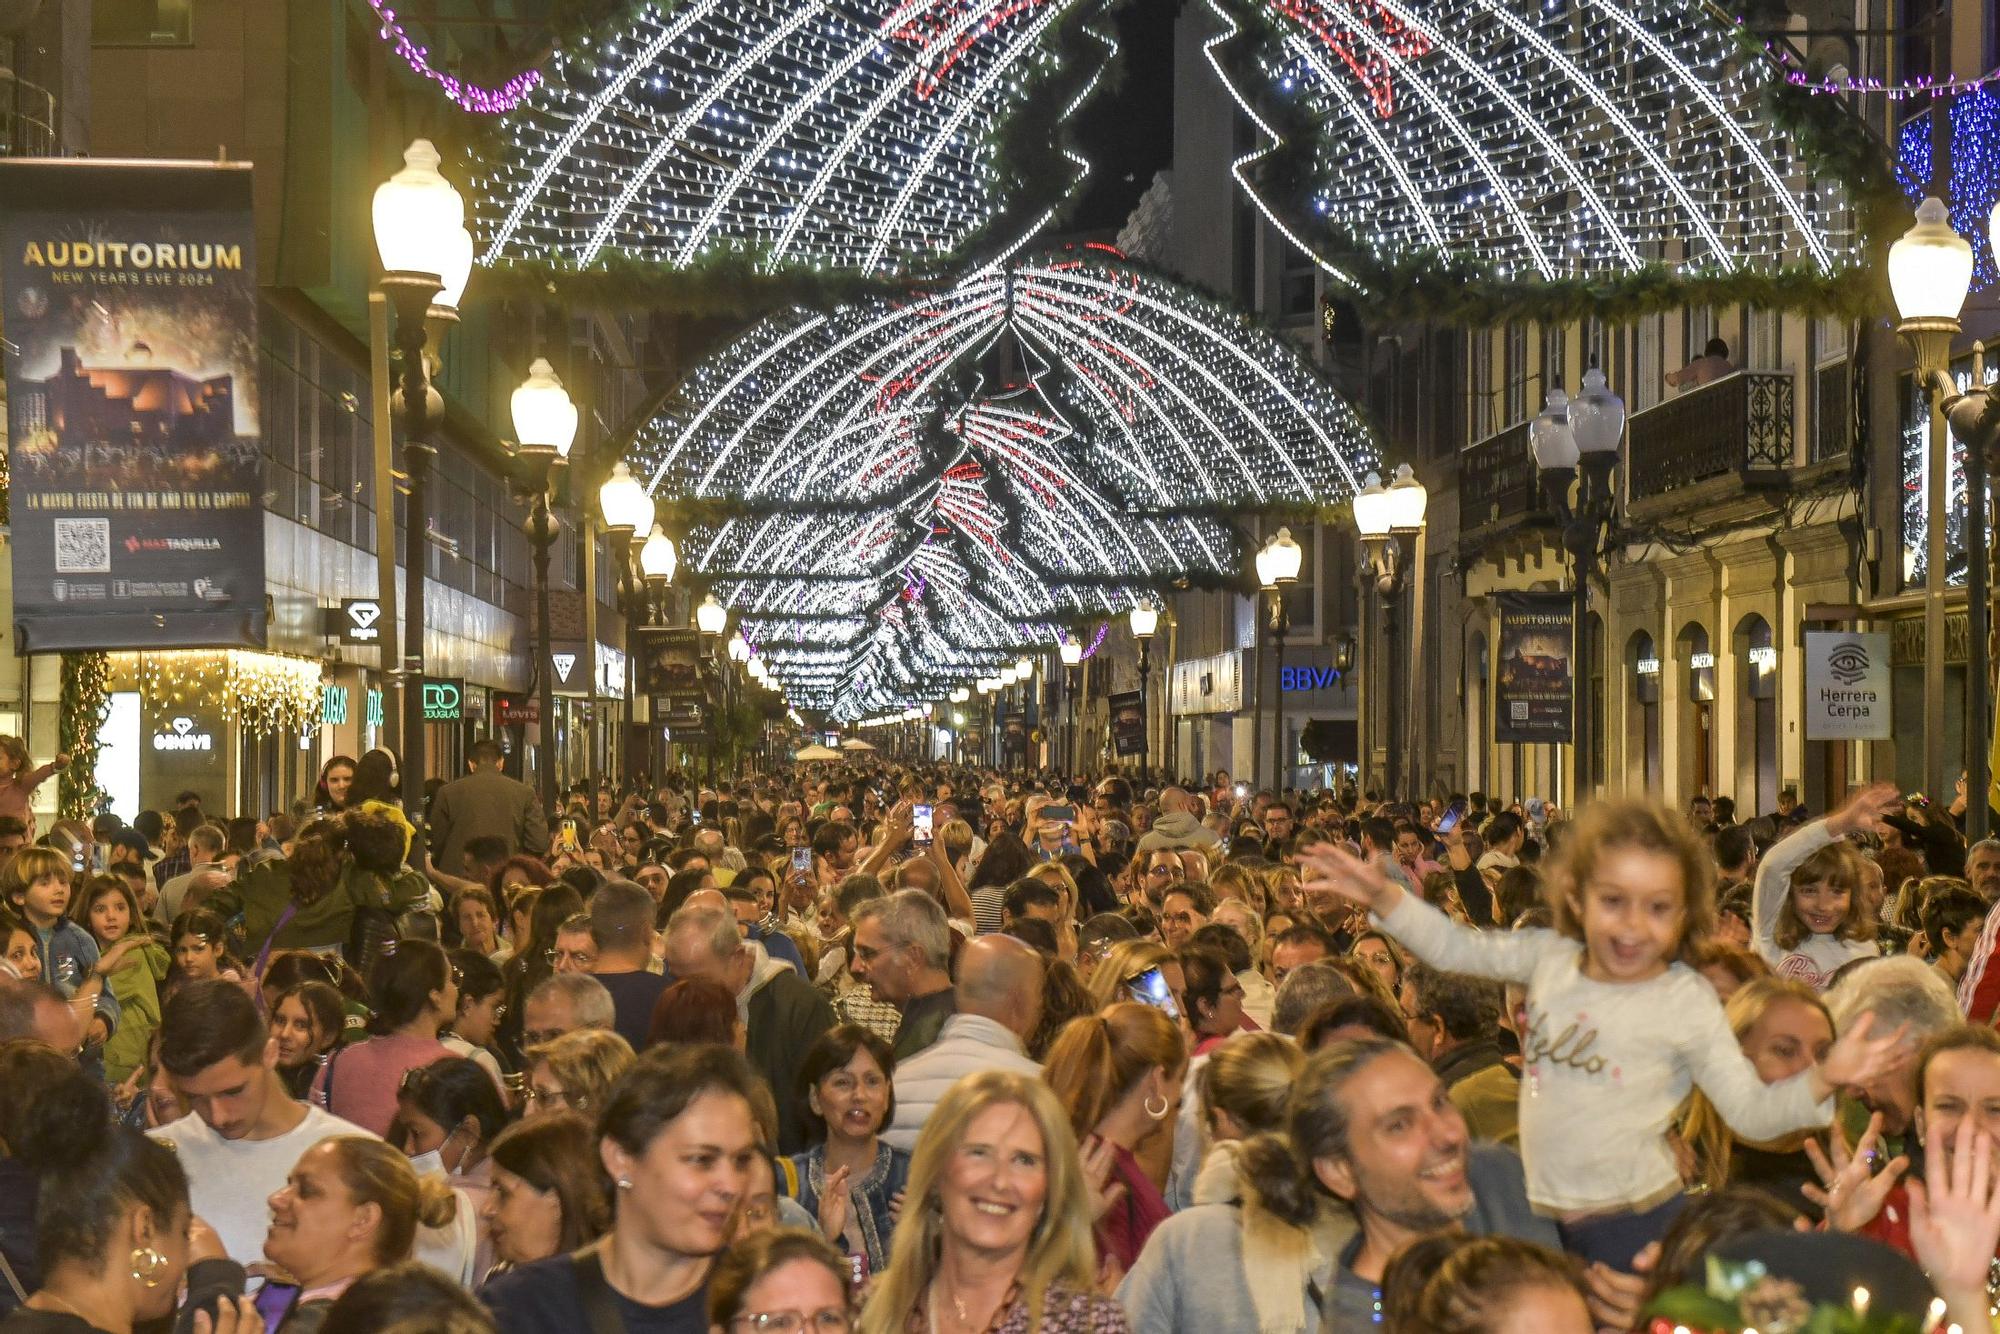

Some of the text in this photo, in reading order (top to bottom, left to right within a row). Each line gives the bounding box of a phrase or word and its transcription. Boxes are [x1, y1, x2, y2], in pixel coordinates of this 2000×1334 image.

[24, 241, 242, 270] AUDITORIUM
[52, 271, 214, 287] NEW YEAR'S EVE 2024
[1504, 614, 1572, 625] AUDITORIUM
[1820, 688, 1877, 702] Herrera
[1827, 703, 1870, 719] Cerpa
